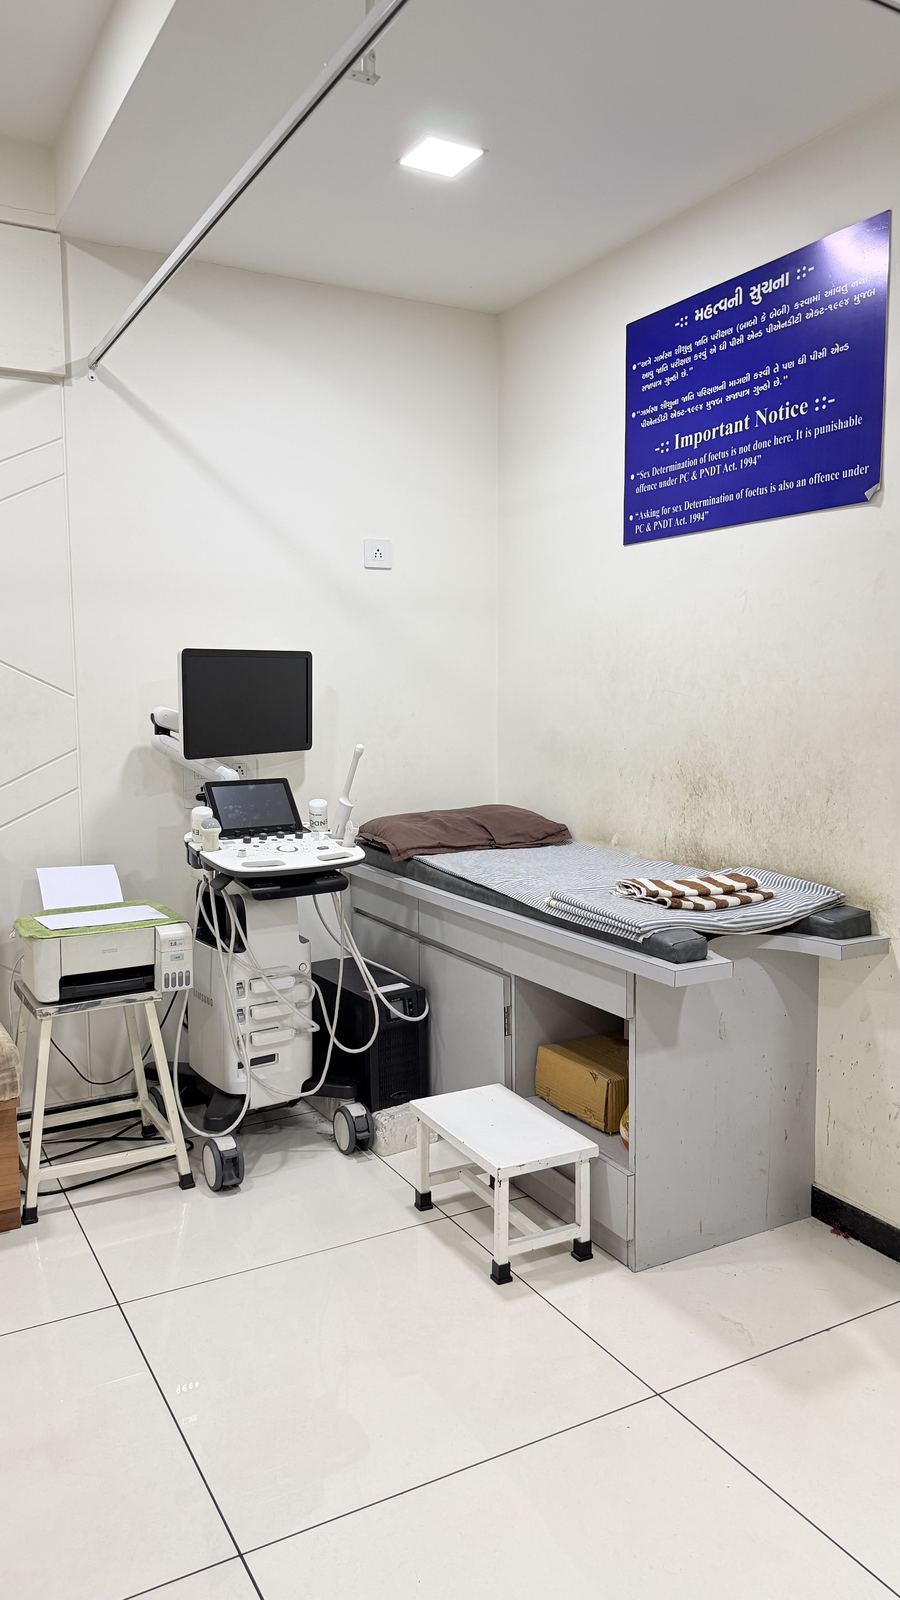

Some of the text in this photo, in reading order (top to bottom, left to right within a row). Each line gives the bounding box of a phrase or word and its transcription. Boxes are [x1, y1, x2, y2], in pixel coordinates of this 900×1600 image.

[694, 286, 743, 321] મહત્વની
[749, 271, 789, 305] સુચના
[694, 334, 708, 347] જાતિ
[710, 327, 733, 341] પરીક્ષણ
[735, 315, 758, 333] (બાબો
[760, 311, 767, 323] કે
[769, 304, 790, 319] બેબી)
[793, 290, 821, 310] કરવામાં
[655, 362, 669, 374] જાતિ
[670, 356, 692, 369] પરીક્ષણ
[693, 347, 708, 361] કરવું
[709, 344, 717, 355] એ
[728, 333, 744, 347] પીસી
[746, 329, 763, 341] એન્ડ
[765, 312, 802, 333] પીએનડીટી
[853, 288, 876, 305] મુજબ
[641, 379, 662, 392] સજાપાત્ર
[680, 391, 695, 403] જાતિ
[728, 372, 751, 387] માગણી
[752, 365, 771, 380] કરવી
[772, 362, 780, 374] તે
[781, 360, 795, 370] પણ
[809, 347, 827, 361] પીસી
[830, 342, 850, 355] એન્ડ
[705, 396, 723, 411] મુજબ
[725, 388, 750, 402] સજાપાત્ર
[752, 379, 771, 396] ગુન્હો
[651, 457, 698, 476] Determination
[699, 452, 708, 464] of
[707, 449, 729, 462] foetus
[730, 445, 737, 457] is
[738, 443, 751, 455] not
[752, 439, 772, 451] done
[773, 434, 794, 446] here.
[795, 429, 803, 440] It
[804, 426, 812, 438] is
[813, 414, 863, 439] punishable
[674, 415, 750, 450] Important
[754, 401, 808, 427] Notice
[635, 482, 658, 494] offence
[658, 476, 678, 489] under
[679, 471, 690, 484] PC
[690, 470, 698, 481] &
[699, 463, 722, 479] PNDT
[722, 462, 738, 474] Act.
[661, 505, 671, 515] for
[671, 504, 683, 514] sex
[684, 492, 734, 511] Determination
[735, 488, 745, 500] of
[745, 486, 768, 498] foetus
[769, 482, 777, 493] is
[778, 479, 794, 491] also
[795, 478, 807, 488] an
[808, 471, 840, 485] offence
[842, 464, 870, 478] under
[634, 523, 645, 534] PC
[645, 522, 652, 532] &
[653, 517, 673, 531] PNDT
[673, 516, 688, 527] Act.
